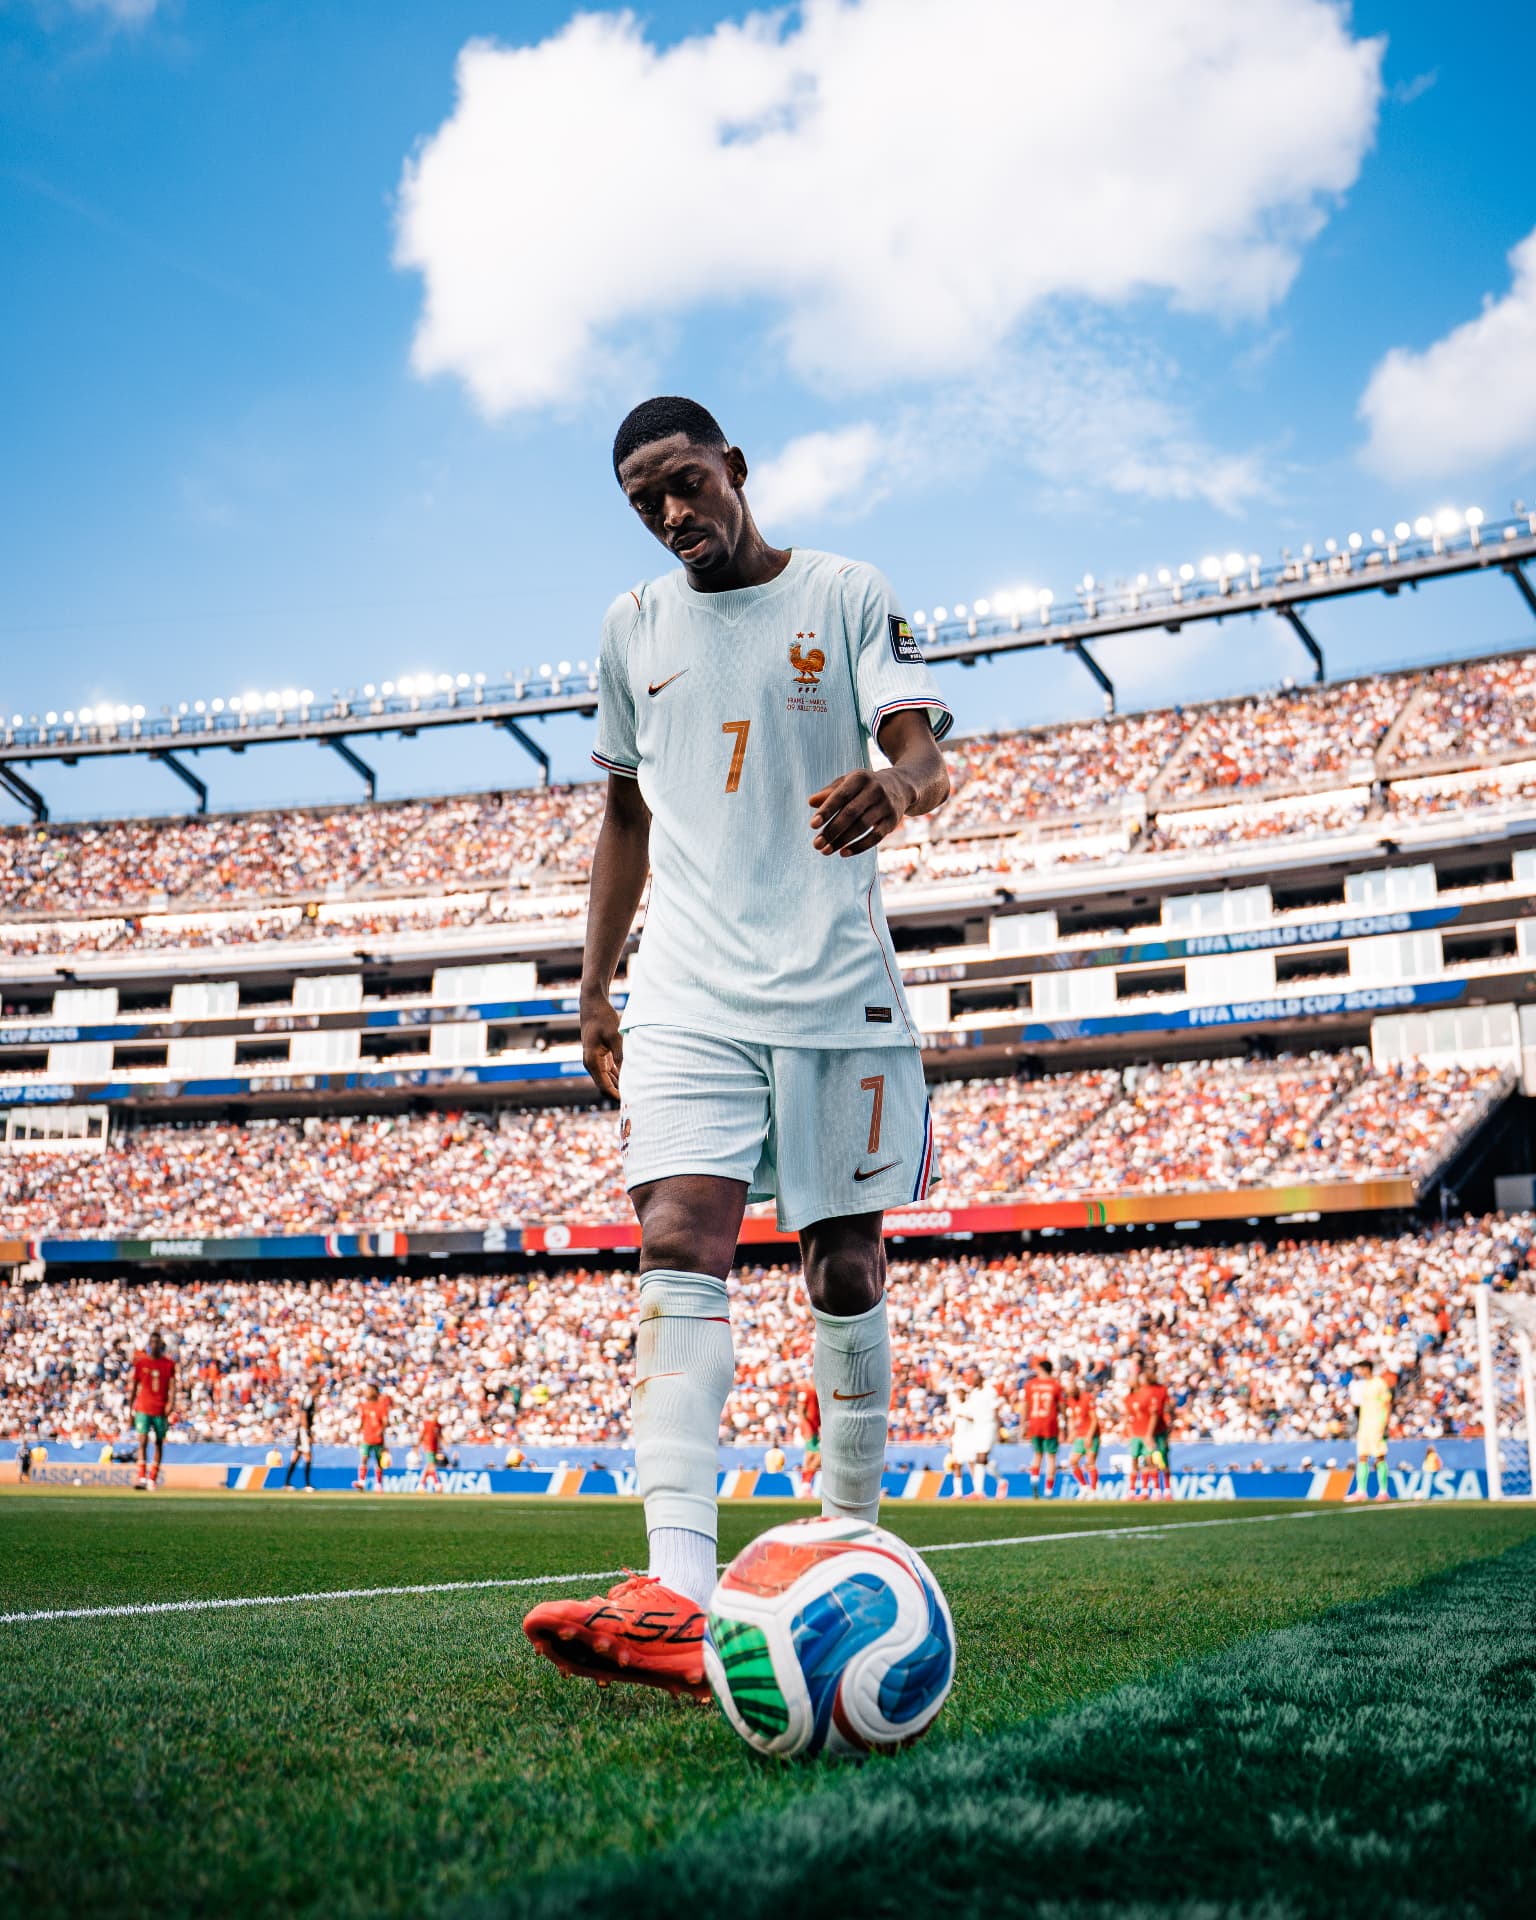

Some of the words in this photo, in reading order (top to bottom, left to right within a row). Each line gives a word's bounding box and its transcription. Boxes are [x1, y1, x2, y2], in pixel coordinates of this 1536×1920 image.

[722, 720, 751, 794] 7
[1185, 937, 1227, 954] FIFA
[1229, 926, 1296, 948] WORLD
[1300, 922, 1339, 941] CUP
[1340, 913, 1411, 935] 2026
[1188, 1007, 1231, 1024] FIFA
[1231, 999, 1299, 1019] WORLD
[1302, 994, 1341, 1012] CUP
[1344, 985, 1415, 1008] 2026
[29, 1026, 79, 1042] 2026
[24, 1084, 74, 1099] 2026
[860, 1074, 885, 1154] 7
[882, 1211, 952, 1230] OROCCO
[150, 1240, 203, 1256] FRANCE
[1030, 1391, 1053, 1417] 13
[438, 1471, 492, 1494] VISA
[1171, 1474, 1236, 1500] VISA
[1389, 1470, 1483, 1500] VISA
